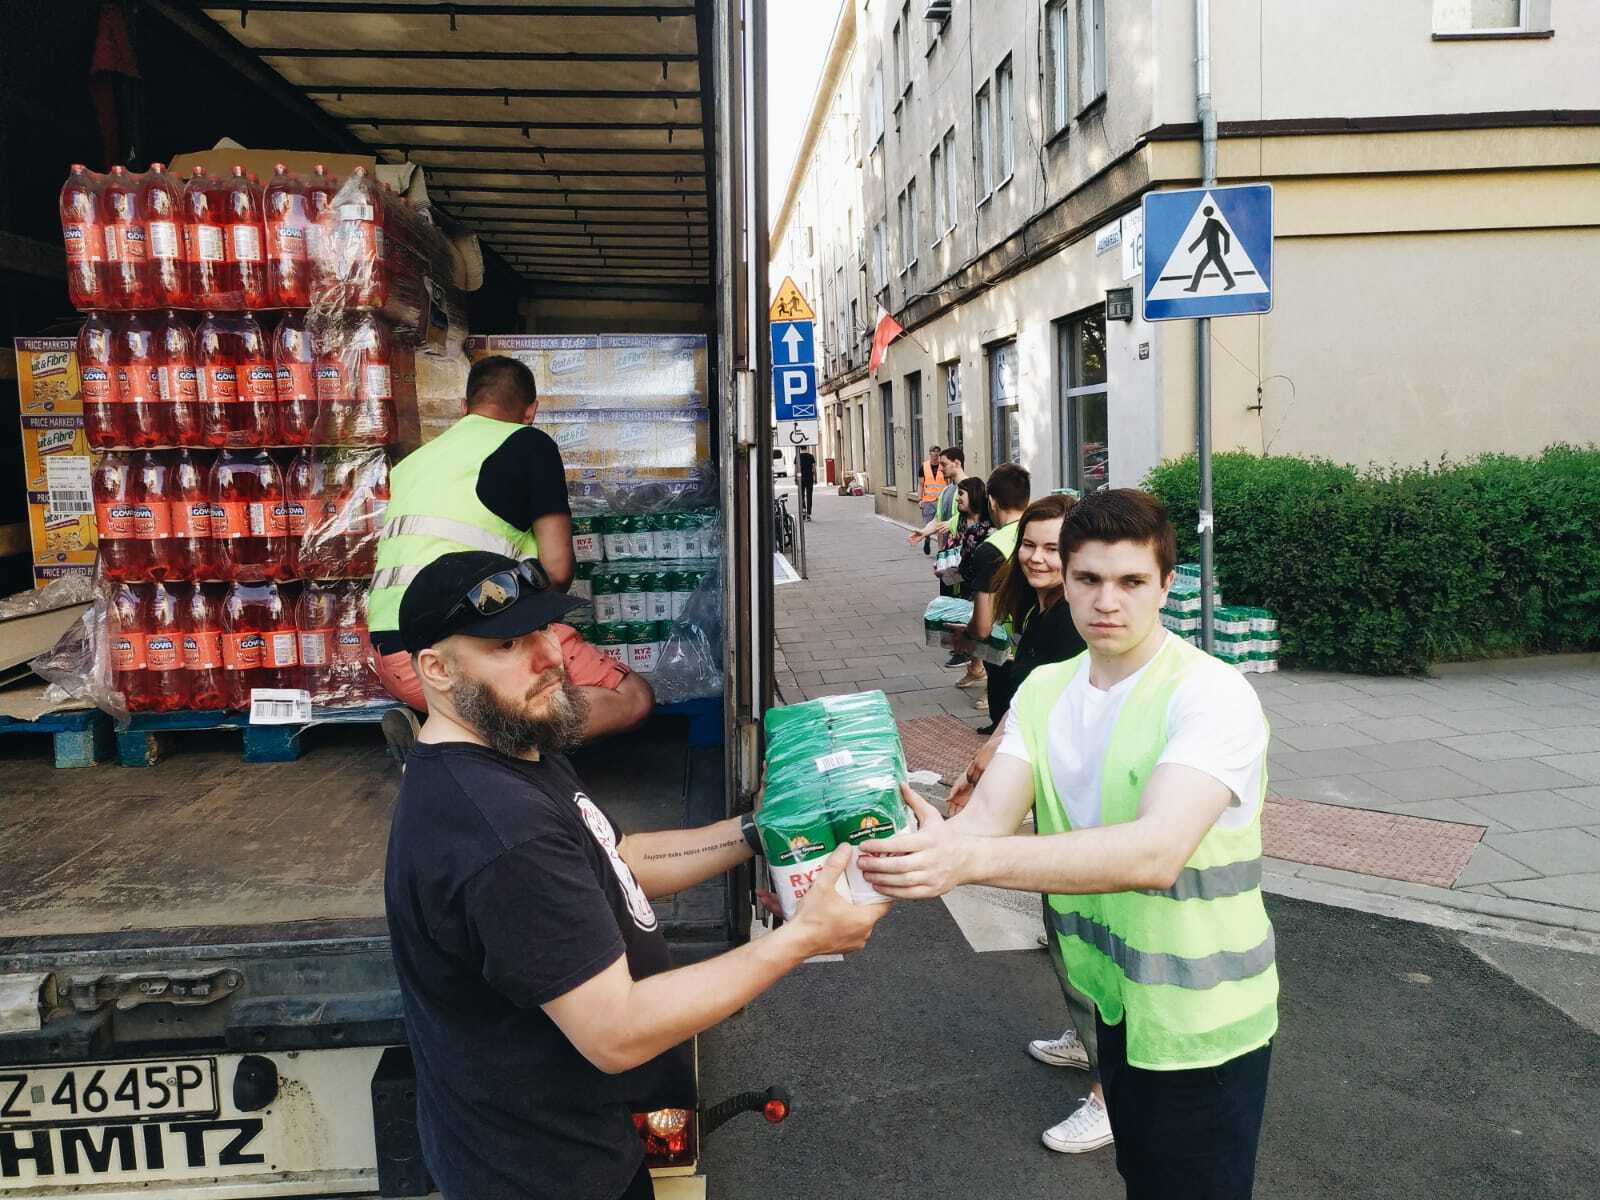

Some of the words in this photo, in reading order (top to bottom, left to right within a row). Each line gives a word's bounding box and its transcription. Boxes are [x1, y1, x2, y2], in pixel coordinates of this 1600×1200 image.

[783, 370, 808, 405] P
[789, 864, 823, 888] RY
[51, 1064, 203, 1115] 4645P
